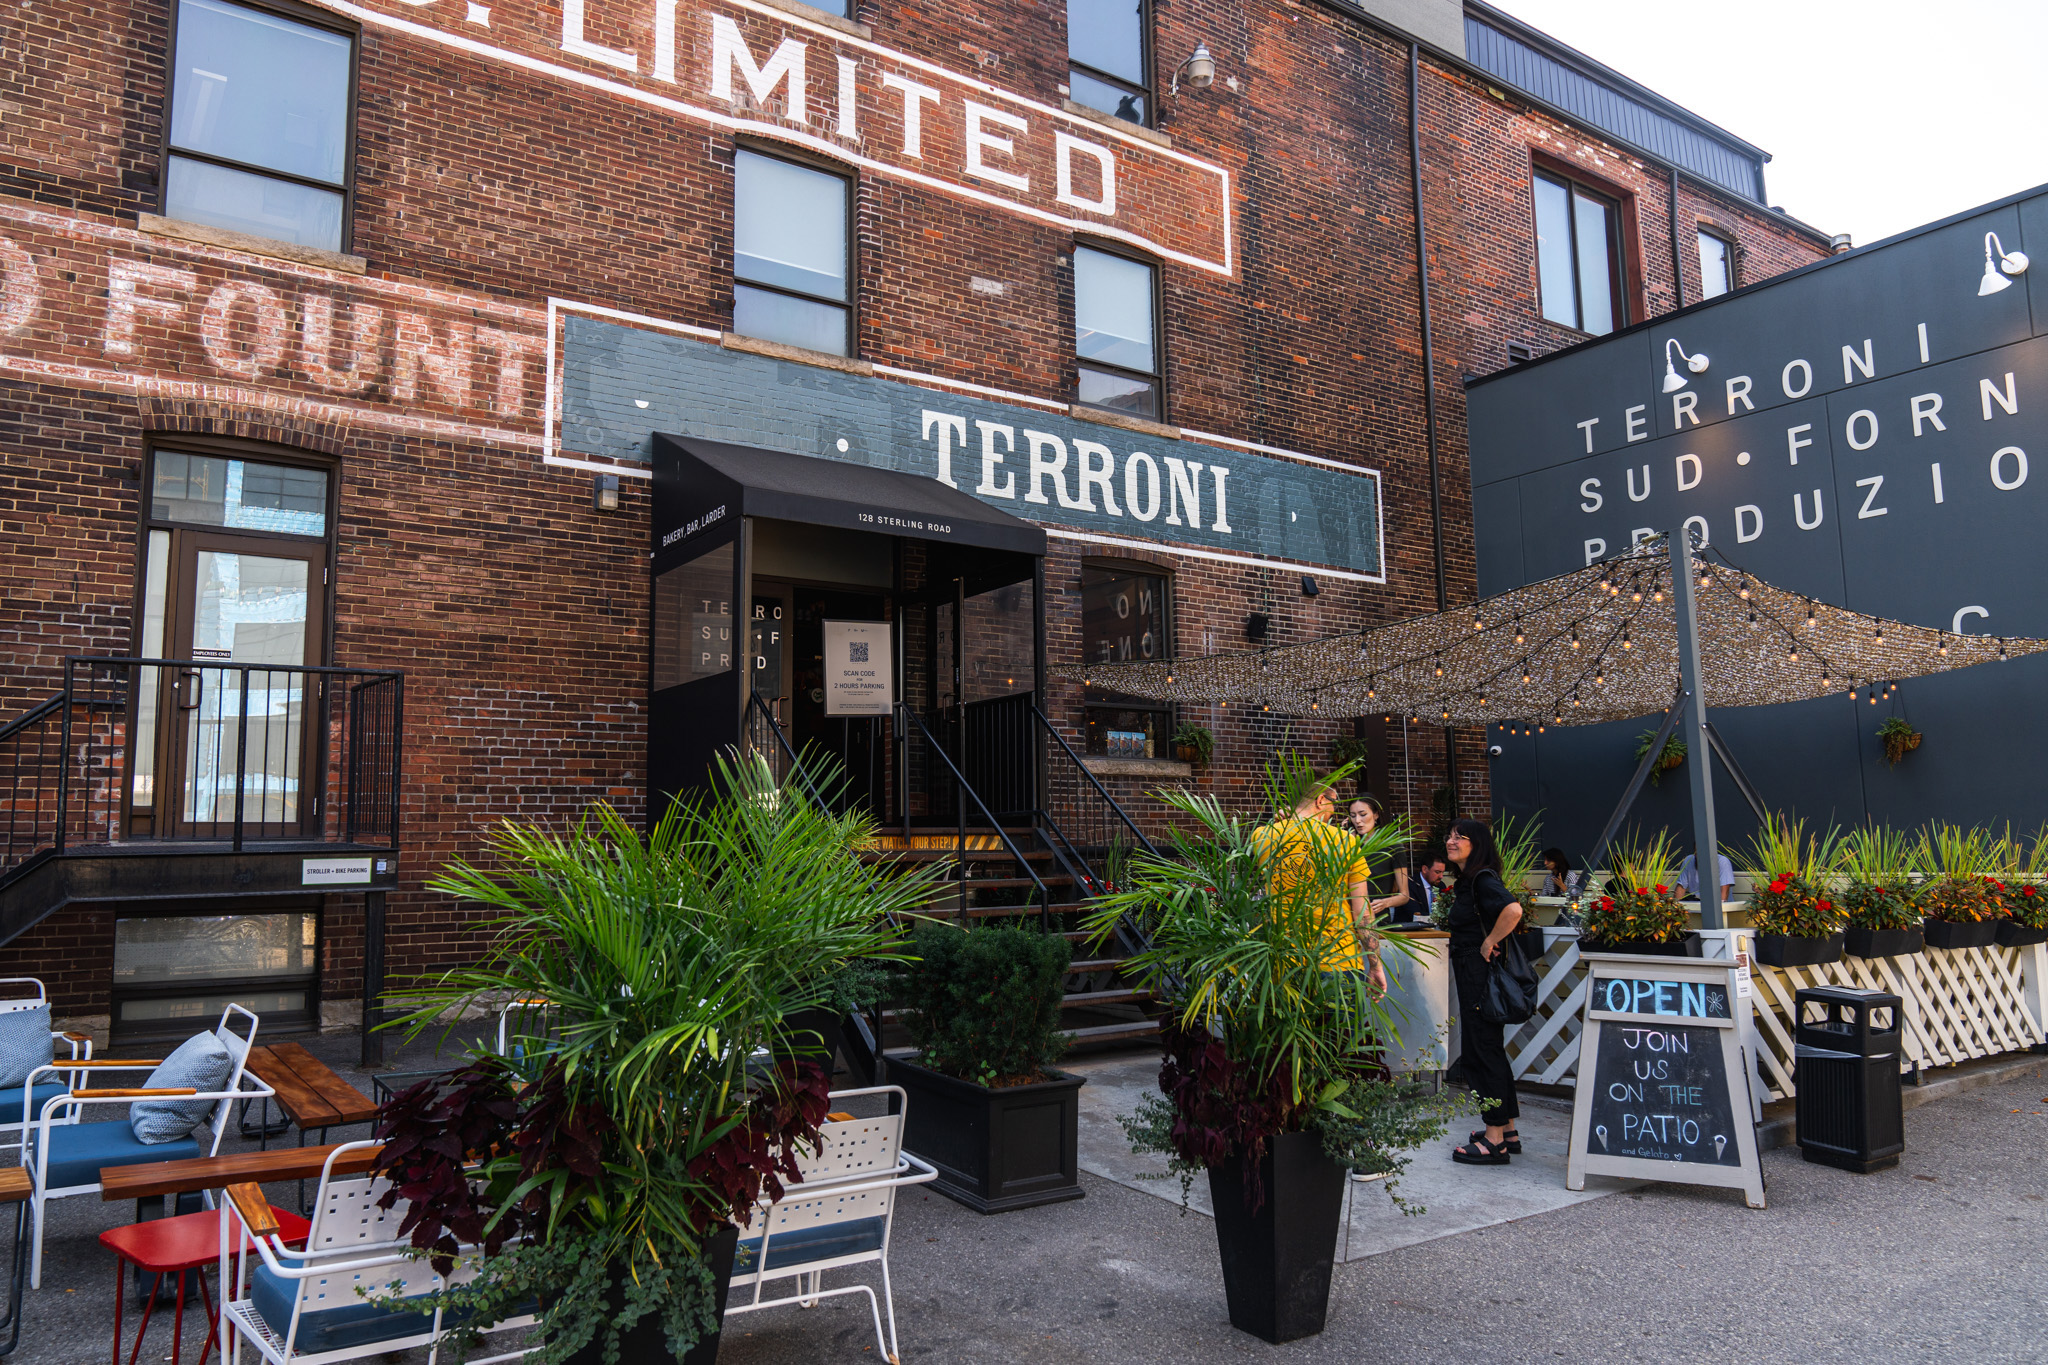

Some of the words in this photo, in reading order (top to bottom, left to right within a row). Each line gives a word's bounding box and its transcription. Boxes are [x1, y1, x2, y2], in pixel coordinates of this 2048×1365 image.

[558, 0, 1117, 217] LIMITED
[1576, 322, 1931, 454] TERRONI
[1579, 453, 1704, 513] SUD
[1787, 371, 2020, 466] FORN
[921, 408, 1233, 534] TERRONI
[701, 504, 726, 527] LARDER
[858, 513, 874, 523] 128
[877, 515, 923, 530] STERLING
[927, 522, 951, 534] ROAD
[1605, 978, 1707, 1018] OPEN
[1621, 1027, 1689, 1054] JOIN
[1633, 1059, 1669, 1080] US
[1608, 1082, 1644, 1103] ON
[1659, 1084, 1703, 1106] THE
[1622, 1113, 1700, 1145] PATIO
[1621, 1147, 1636, 1155] and
[1637, 1146, 1670, 1159] Gelato
